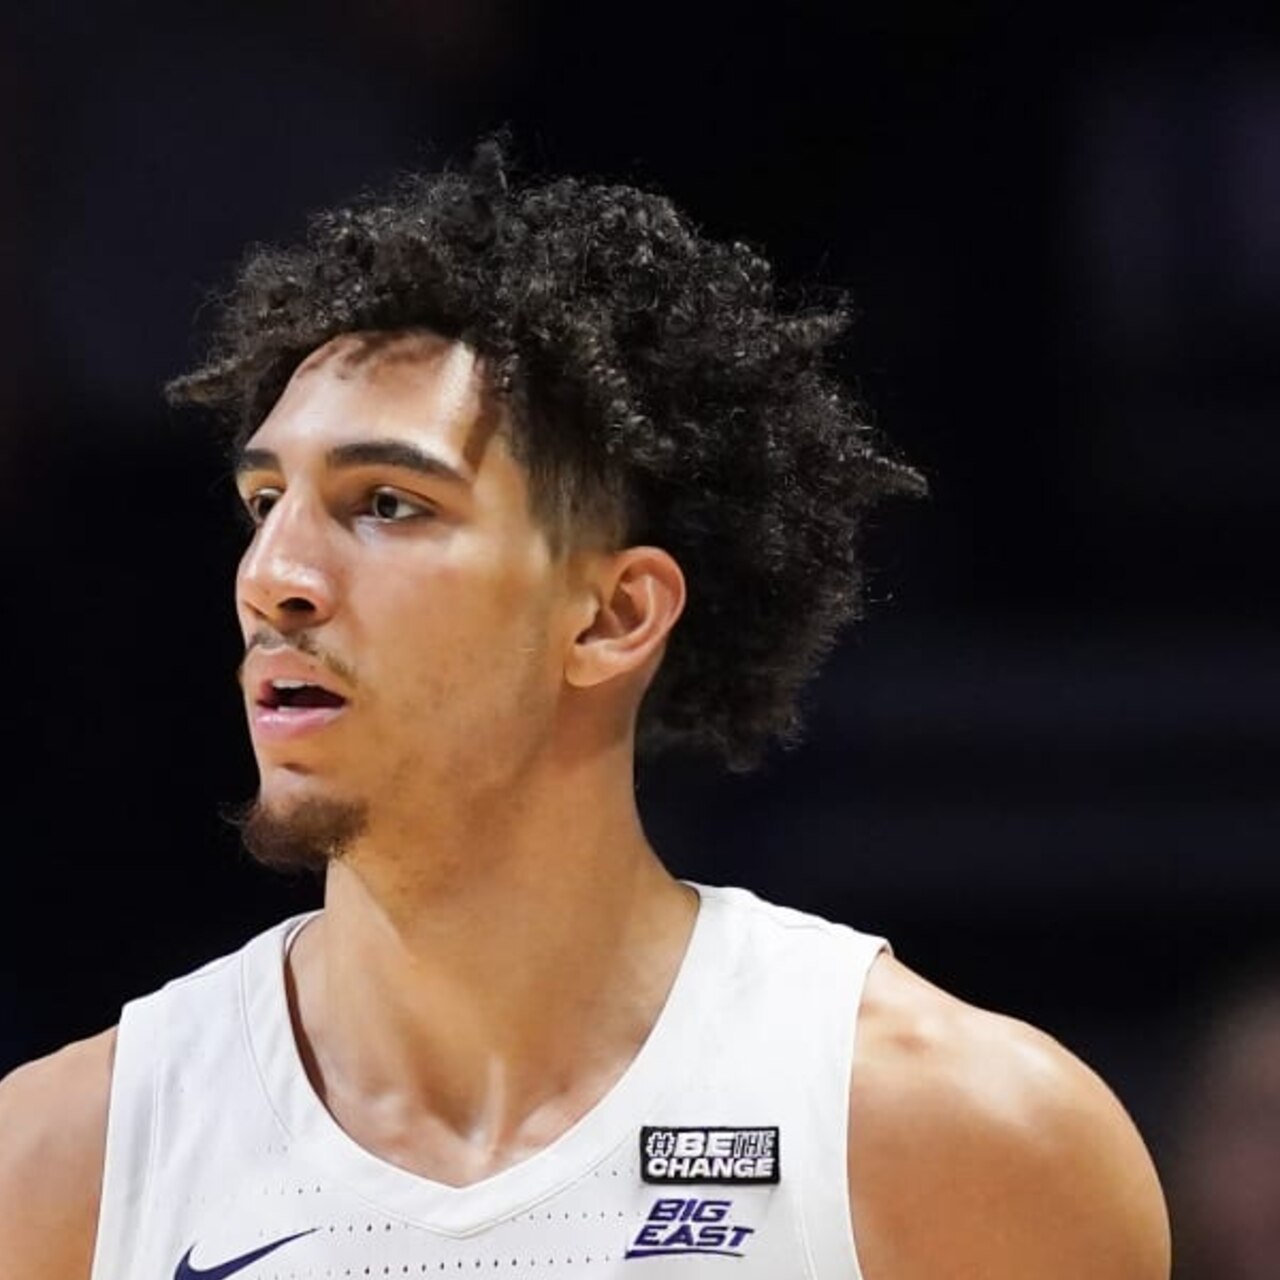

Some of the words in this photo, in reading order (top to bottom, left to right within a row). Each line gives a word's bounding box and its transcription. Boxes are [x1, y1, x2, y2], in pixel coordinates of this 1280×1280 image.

[646, 1158, 775, 1178] CHANGE
[647, 1199, 732, 1222] BIG
[634, 1224, 755, 1247] EAST
